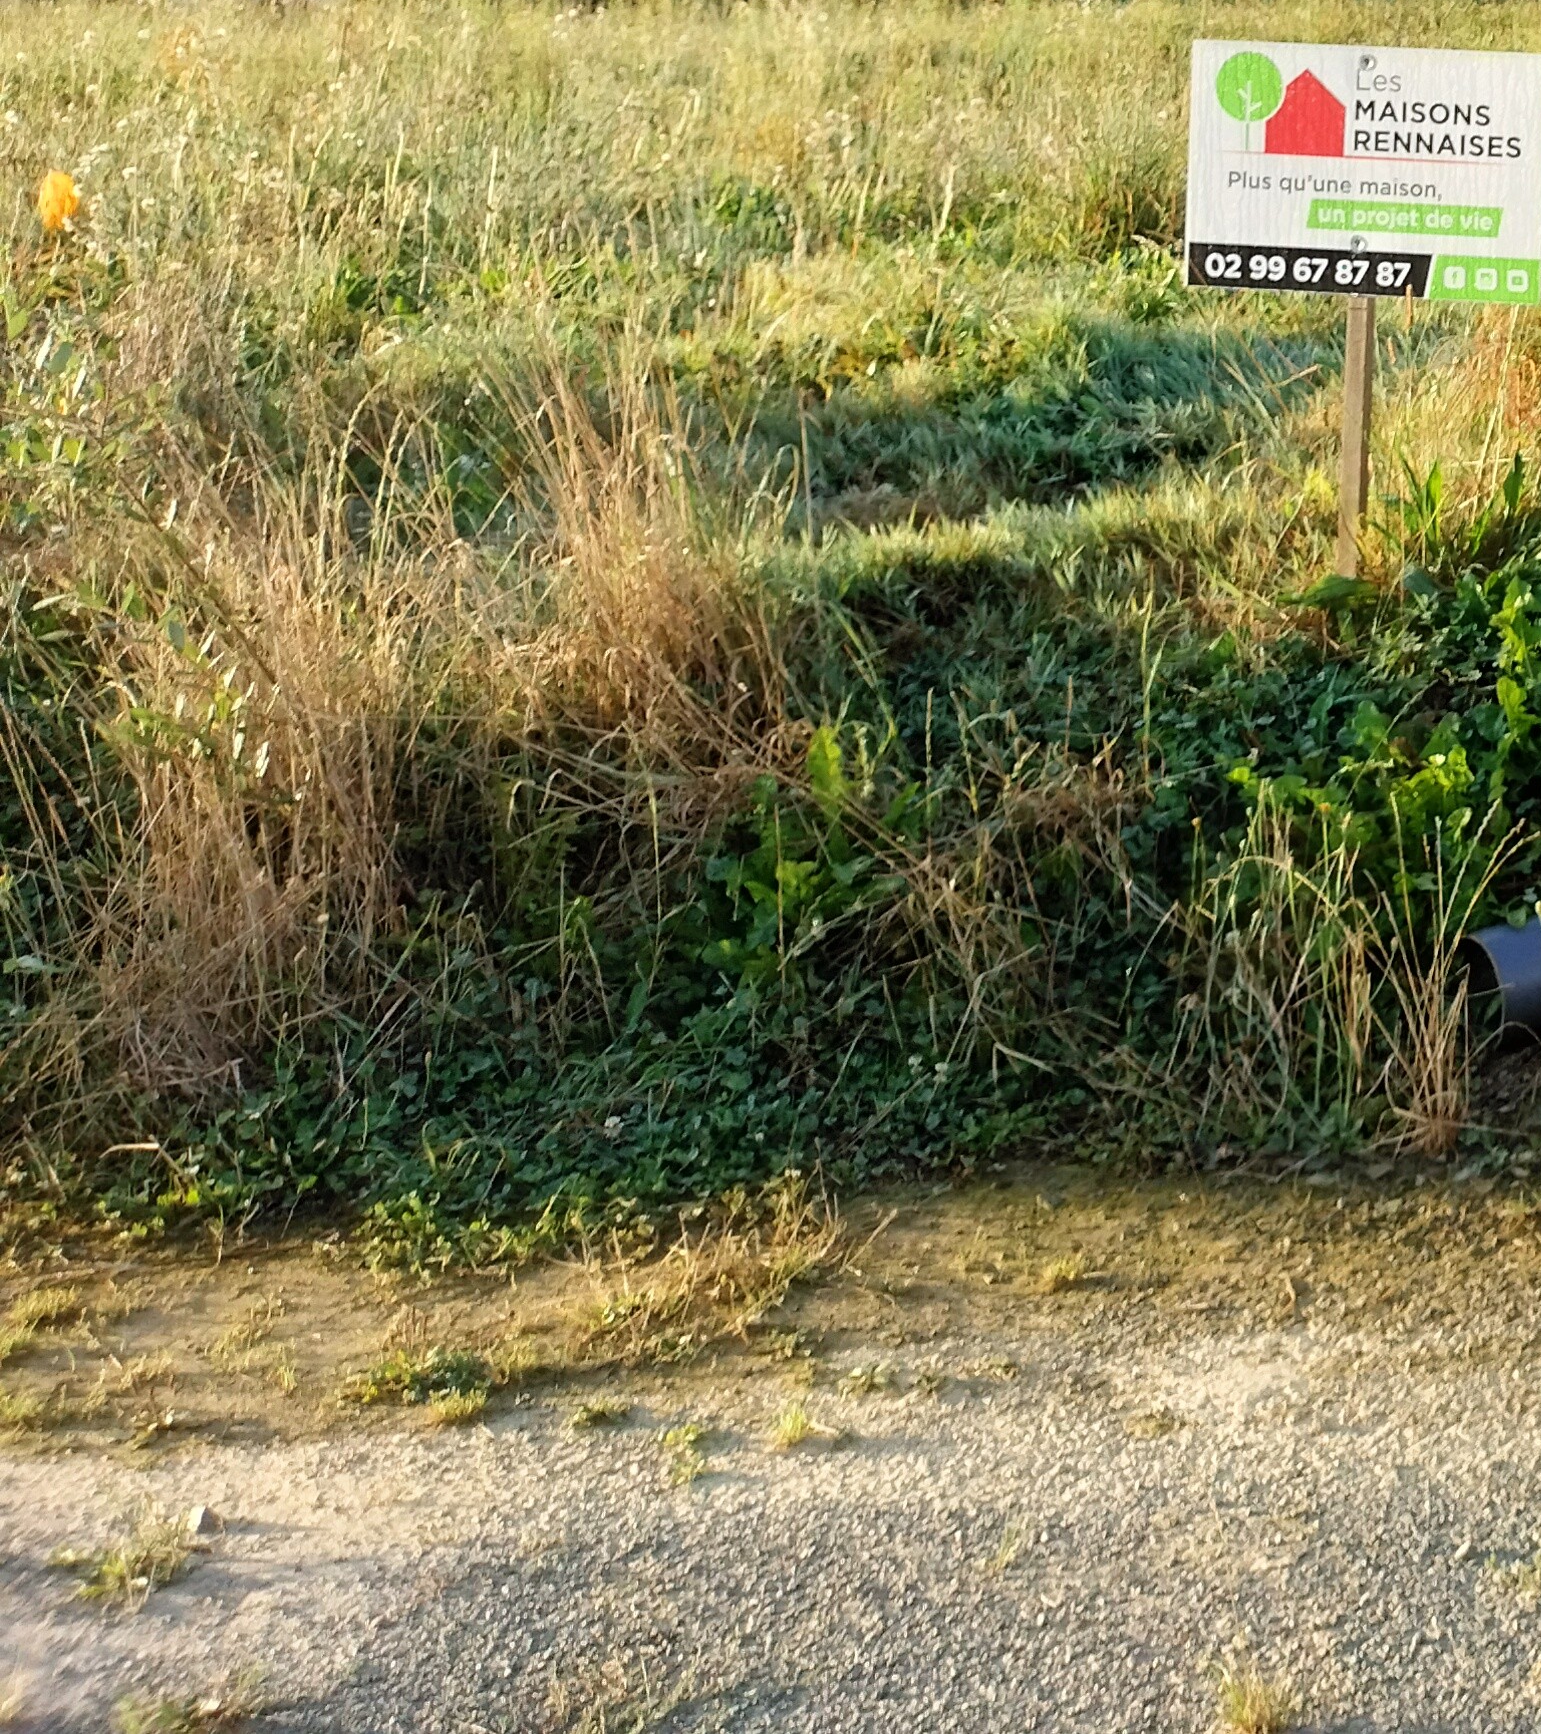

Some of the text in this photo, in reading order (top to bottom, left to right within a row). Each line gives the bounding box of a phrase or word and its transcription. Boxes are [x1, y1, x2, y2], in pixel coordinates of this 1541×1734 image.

[1356, 69, 1402, 93] Les
[1355, 100, 1491, 126] MAISONS
[1353, 130, 1522, 159] RENNAISES
[1228, 171, 1443, 201] Plus qu'une maison,
[1317, 203, 1494, 232] un projet de vie
[1204, 252, 1412, 288] 02 99 67 87 87
